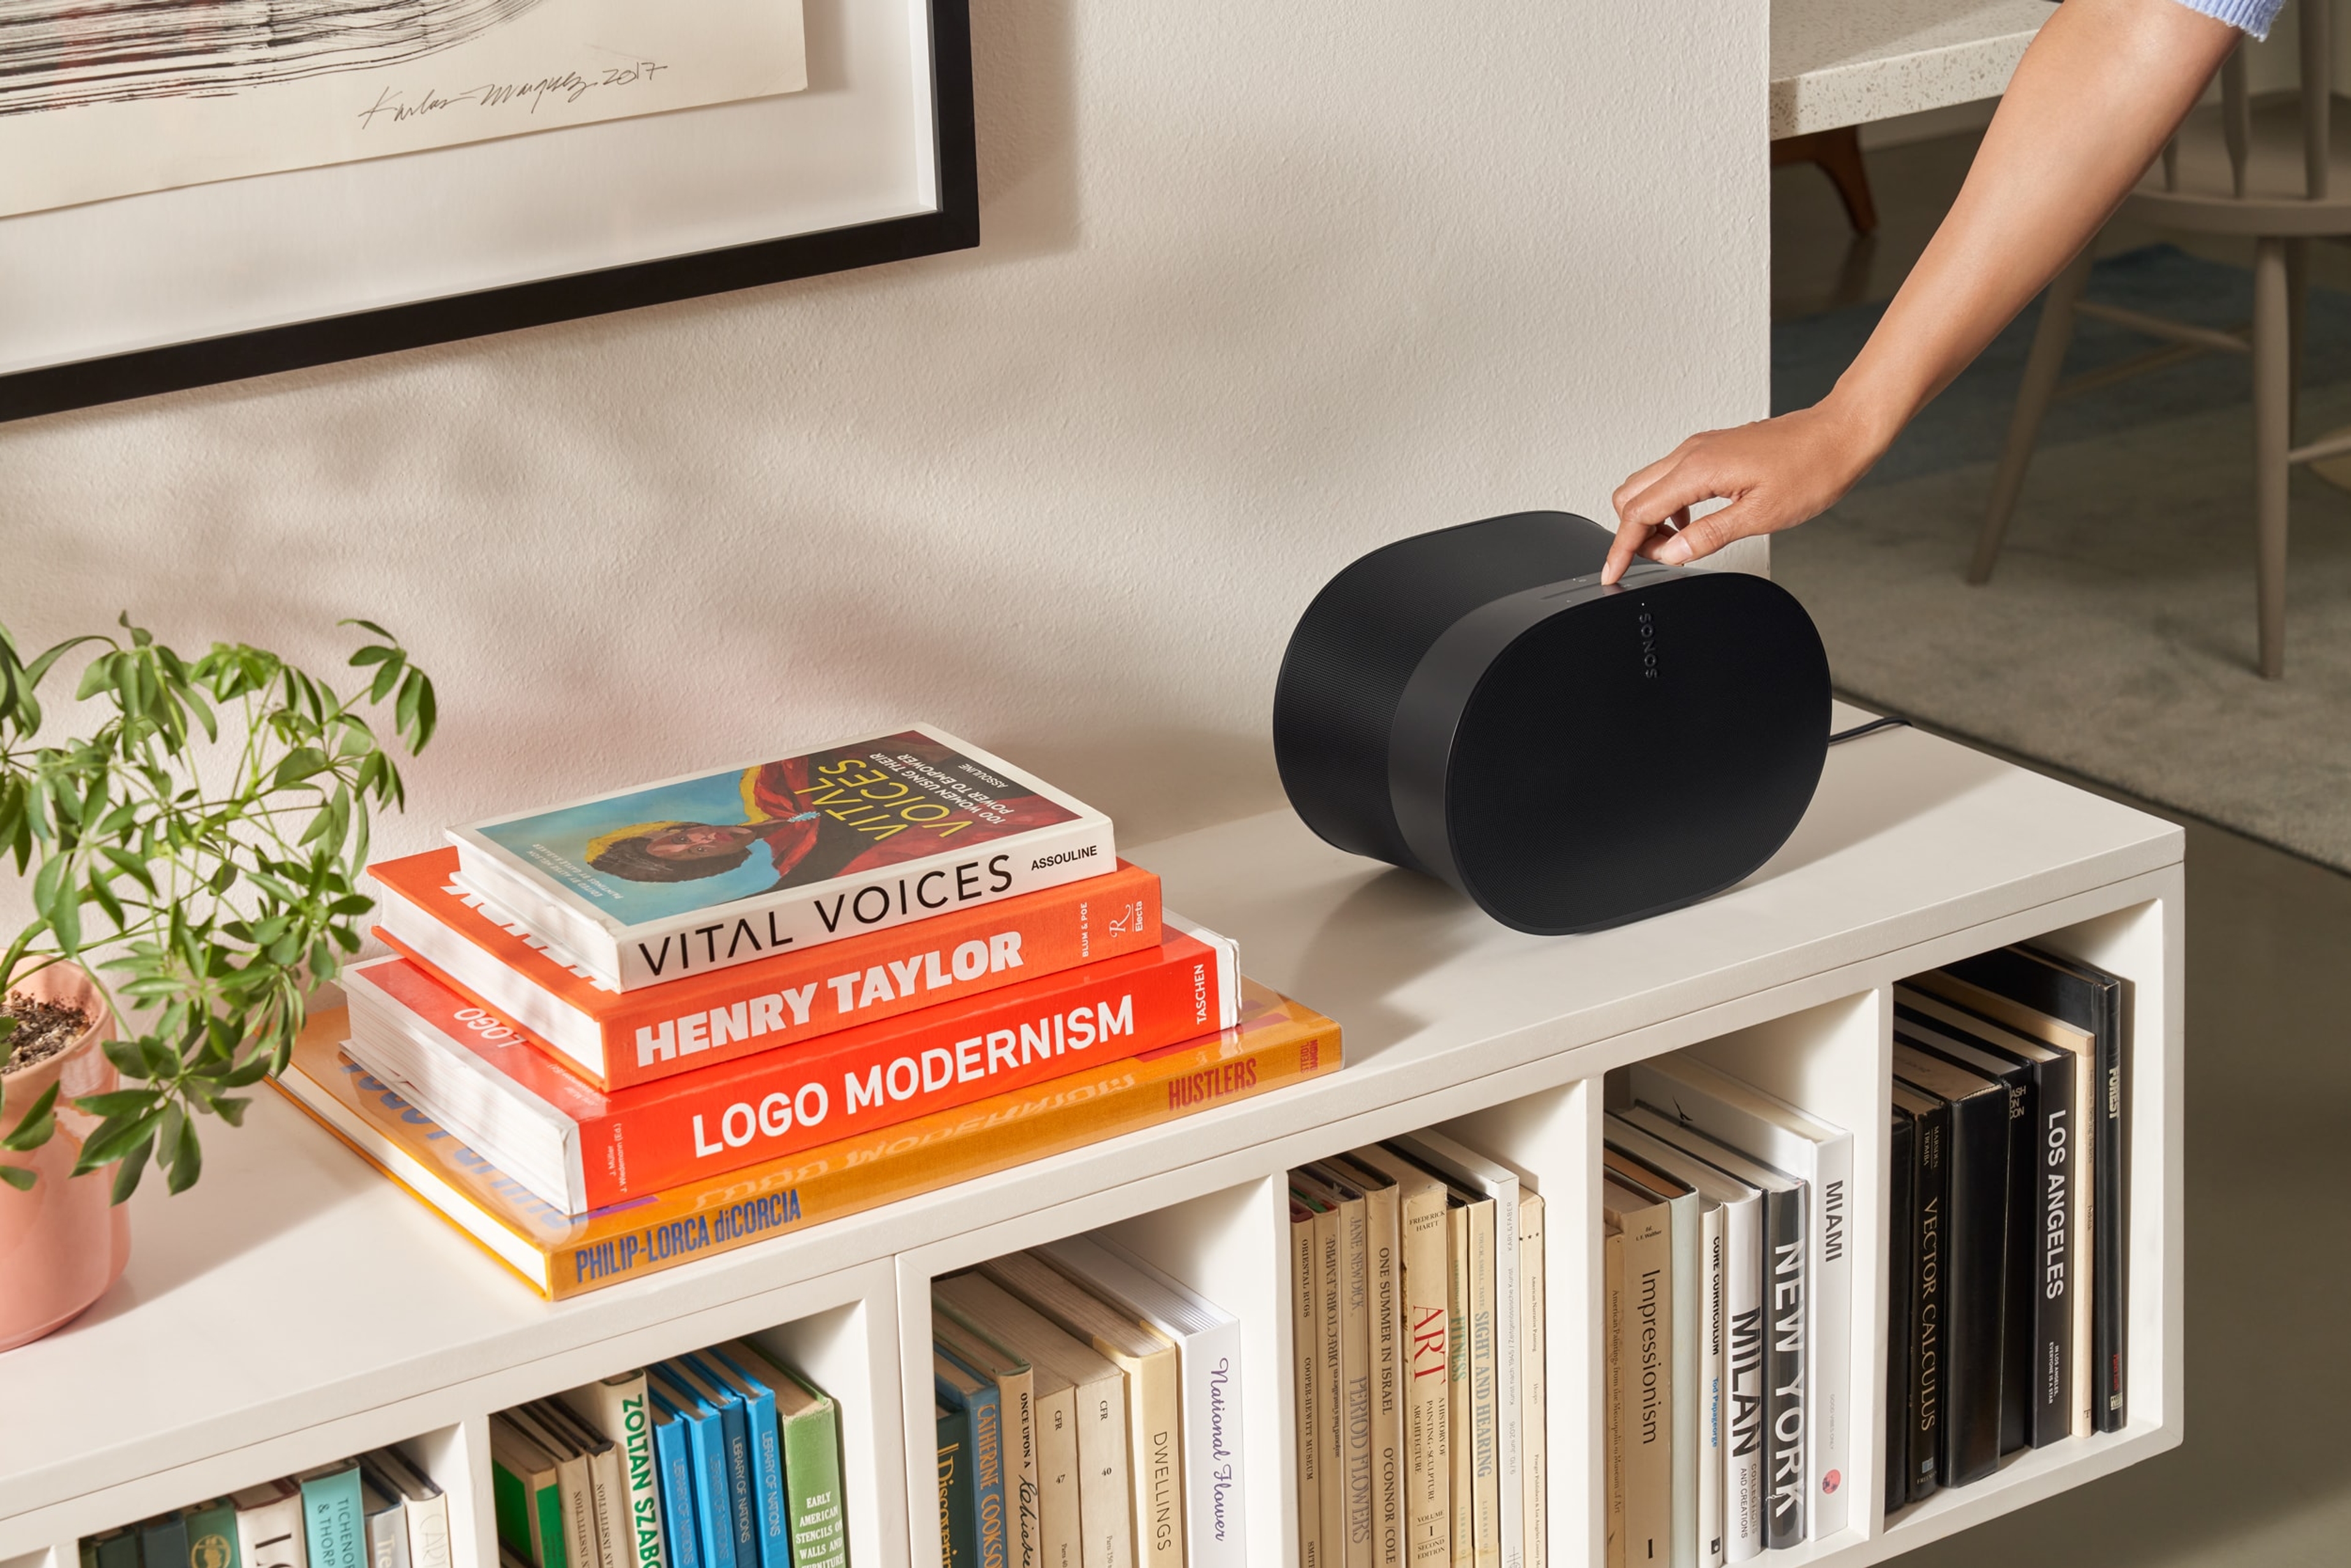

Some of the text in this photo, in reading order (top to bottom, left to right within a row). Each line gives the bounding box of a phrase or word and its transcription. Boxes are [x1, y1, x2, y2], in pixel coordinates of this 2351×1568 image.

[602, 62, 668, 85] 2017
[1640, 613, 1657, 678] SONOS
[819, 759, 973, 838] VOICES
[869, 753, 1006, 824] 100 WOMEN USING THEIR
[897, 754, 1014, 814] POWER TO EMPOWER
[958, 763, 1008, 789] ASSOULINE
[793, 778, 909, 841] VITAL
[638, 909, 793, 977] VITAL
[814, 854, 1013, 934] VOICES
[1030, 845, 1098, 872] ASSOULINE
[635, 931, 1024, 1068] HENRY TAYLOR
[1196, 964, 1207, 1026] TASCHEN
[454, 1008, 528, 1049] LOGO
[1300, 1041, 1310, 1074] STEIDL
[692, 994, 1134, 1159] LOGO MODERNISM
[1168, 1057, 1258, 1111] HUSTLERS
[2109, 1065, 2120, 1119] FOREST
[576, 1189, 801, 1283] PHILIP-LORCA diCORCIA
[1409, 1210, 1445, 1226] FREDERICK
[1416, 1220, 1439, 1232] HARTT
[1826, 1180, 1843, 1262] MIAMI
[2046, 1109, 2066, 1300] LOS ANGELES
[1350, 1217, 1363, 1310] JANE NEWDICK
[1379, 1247, 1393, 1415] ONE SUMMER IN ISRAEL
[1611, 1289, 1621, 1328] American
[1921, 1196, 1938, 1431] VECTOR CALCULUS
[1332, 1368, 1339, 1379] en
[1413, 1305, 1447, 1384] ART
[1451, 1316, 1466, 1382] FITNESS
[1637, 1269, 1662, 1444] Impressionism
[1775, 1237, 1805, 1518] NEW YORK
[1021, 1392, 1029, 1424] ONCE
[1475, 1311, 1491, 1477] SIGHT AND HEARING
[1732, 1306, 1761, 1457] MILAN
[622, 1394, 651, 1491] ZOLTAN
[978, 1403, 999, 1490] CATHERINE
[1021, 1425, 1031, 1458] UPON
[1210, 1357, 1233, 1542] National Flower
[1349, 1376, 1370, 1544] PERIOD FLOWERS
[1439, 1444, 1445, 1456] OF
[732, 1436, 750, 1544] LIBRARY OF NATIONS
[762, 1431, 780, 1537] LIBRARY OF NATIONS
[806, 1491, 831, 1509] EARLY
[1056, 1474, 1065, 1484] 47
[1153, 1431, 1172, 1551] DWELLINGS
[1384, 1447, 1395, 1521] O'CONNOR
[318, 1504, 336, 1568] & THORP
[574, 1490, 589, 1558] INSTITUTION
[596, 1483, 612, 1549] INSTITUTION
[796, 1519, 842, 1544] STENCILS ON
[800, 1506, 839, 1528] AMERICAN
[800, 1538, 842, 1559] WALLS AND
[1417, 1510, 1444, 1523] VOLUME
[1417, 1539, 1445, 1551] SECOND
[1417, 1547, 1445, 1559] EDITION
